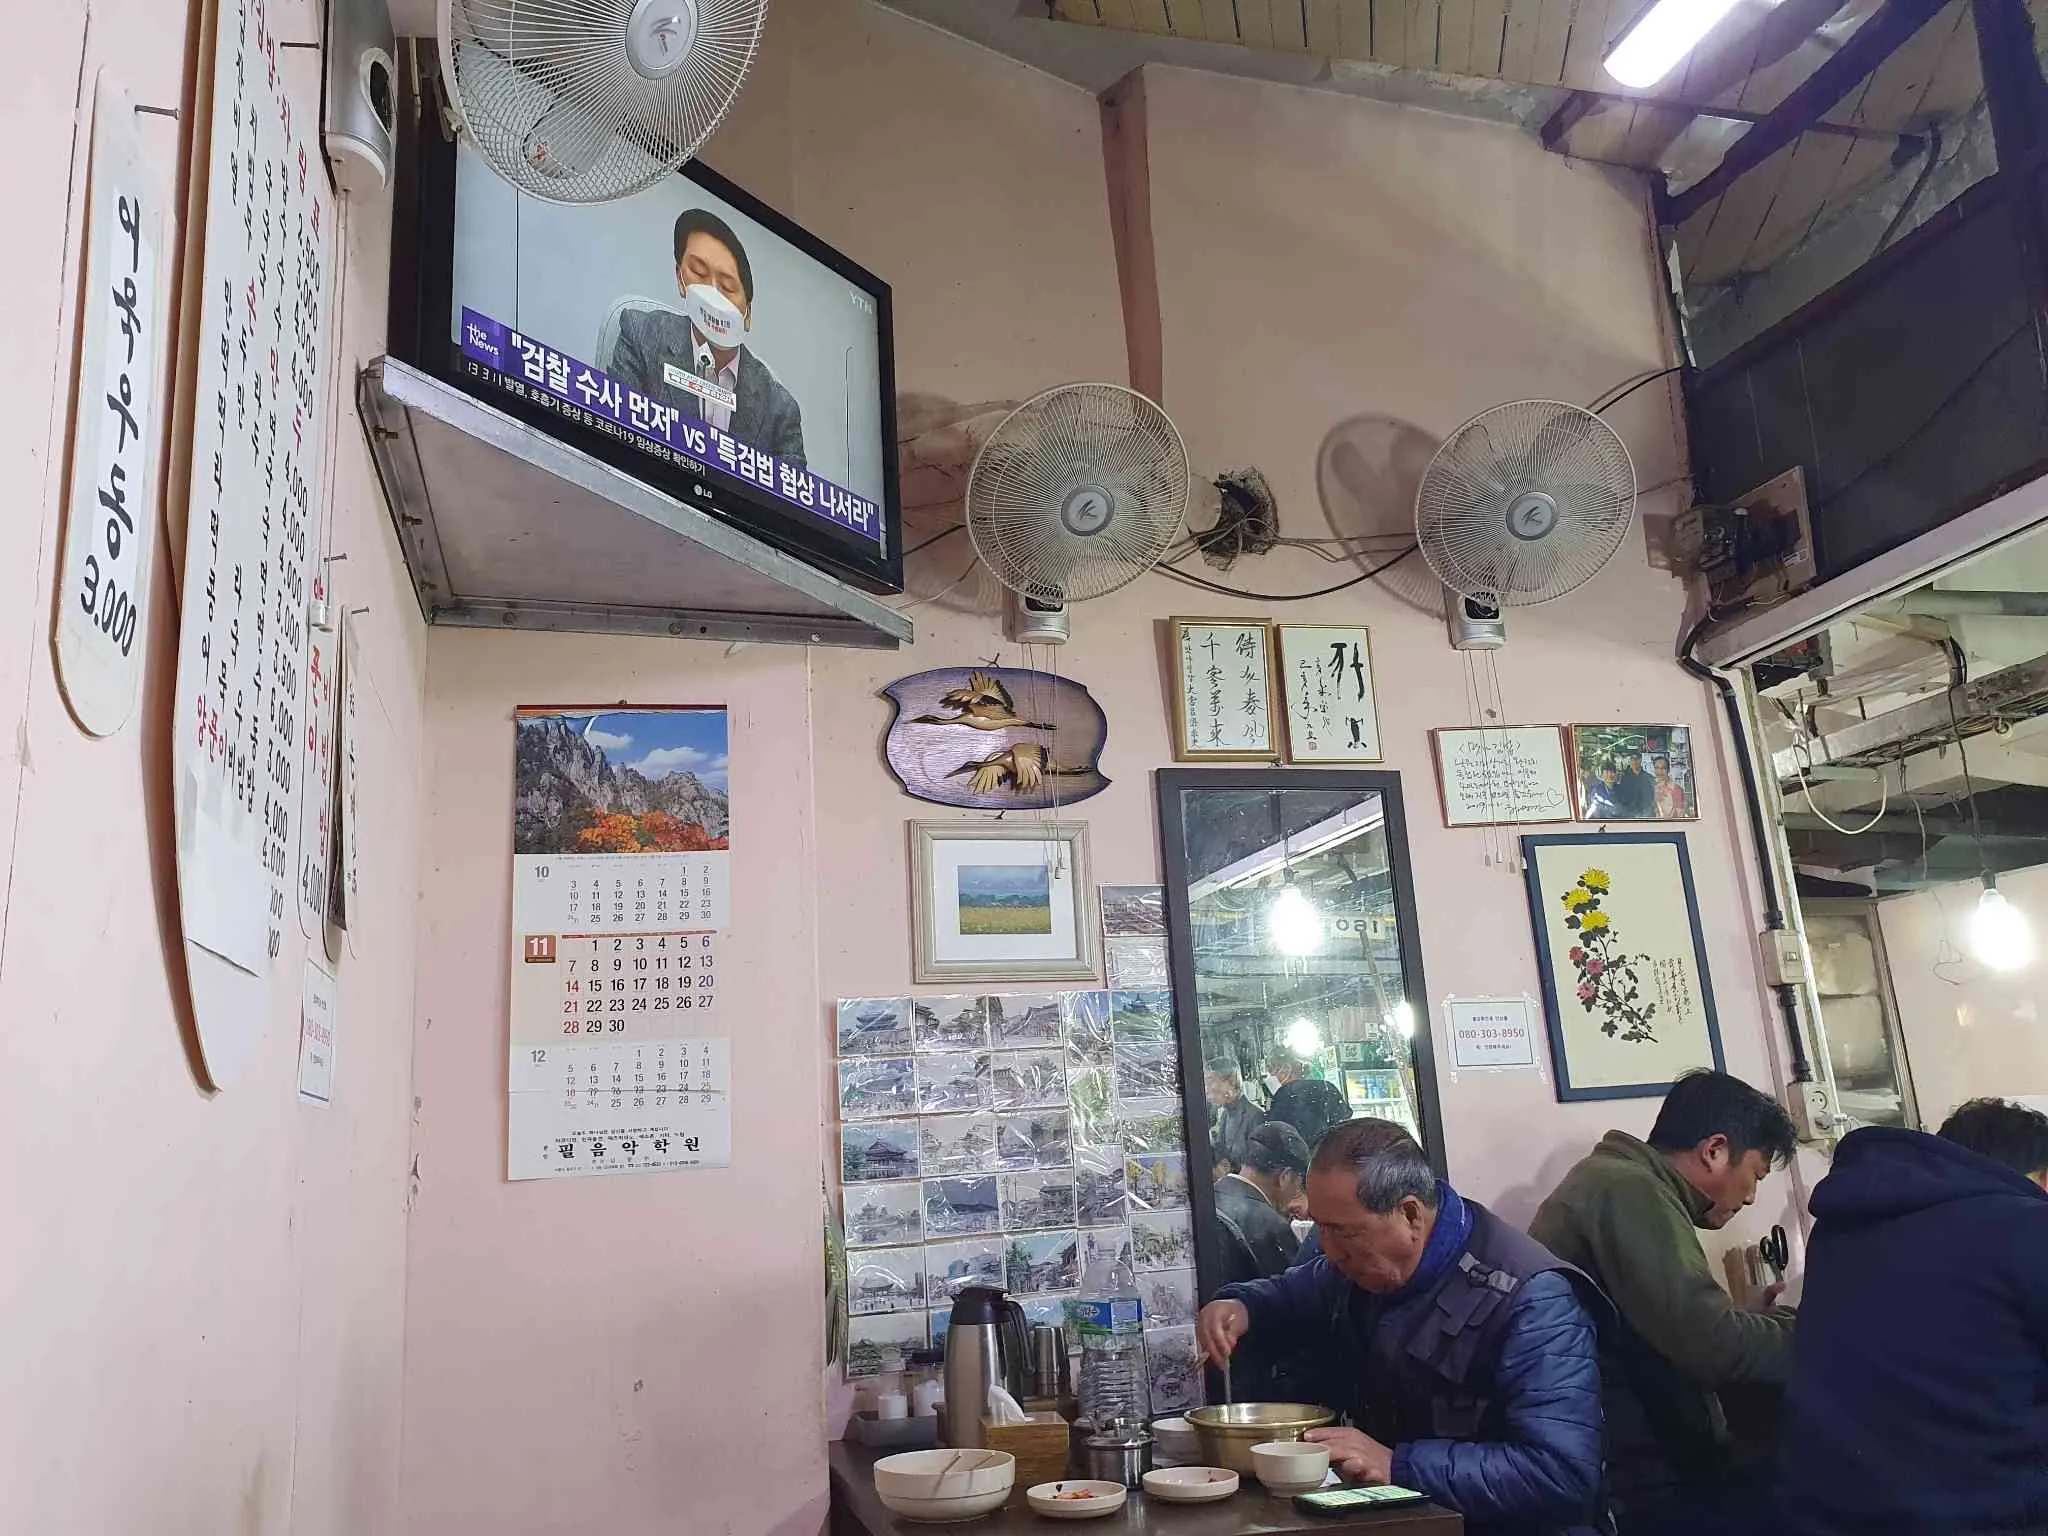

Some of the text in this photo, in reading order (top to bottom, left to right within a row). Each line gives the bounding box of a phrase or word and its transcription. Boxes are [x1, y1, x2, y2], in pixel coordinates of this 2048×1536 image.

[298, 213, 320, 292] 2.500
[296, 256, 317, 330] 3.000
[295, 303, 316, 374] 4.000
[467, 323, 487, 340] the
[470, 334, 499, 356] News
[99, 196, 142, 561] 어묵우동
[292, 352, 313, 420] 4.000
[511, 332, 570, 395] "검찰
[576, 370, 622, 418] 수사
[629, 391, 679, 441] 먼저"
[710, 427, 774, 489] "특검법
[779, 463, 815, 506] 협상
[819, 482, 874, 531] 나서라"
[594, 417, 634, 444] 코로나19
[673, 452, 706, 477] 확인하기
[285, 452, 307, 516] 4.000
[704, 489, 712, 499] LG
[282, 499, 304, 561] 4.000
[80, 553, 137, 656] 3.000
[279, 548, 302, 607] 4.000
[276, 589, 299, 652] 3.000
[273, 639, 296, 700] 3.500
[271, 686, 293, 745] 6.000
[267, 738, 290, 794] 3.000
[265, 794, 287, 843] 4.000
[301, 855, 324, 915] 4.000
[535, 866, 549, 878] 10
[529, 937, 548, 956] 11
[568, 956, 713, 972] 7 8 9 10 11 12 13
[592, 936, 710, 952] 1 2 3 4 5 6
[563, 995, 713, 1013] 21 22 23 24 25 26 27
[566, 975, 713, 992] 14 15 16 17 18 19 20
[563, 1019, 624, 1033] 28 29 30
[1459, 1028, 1525, 1039] 080-303-8950
[531, 1050, 546, 1062] 12
